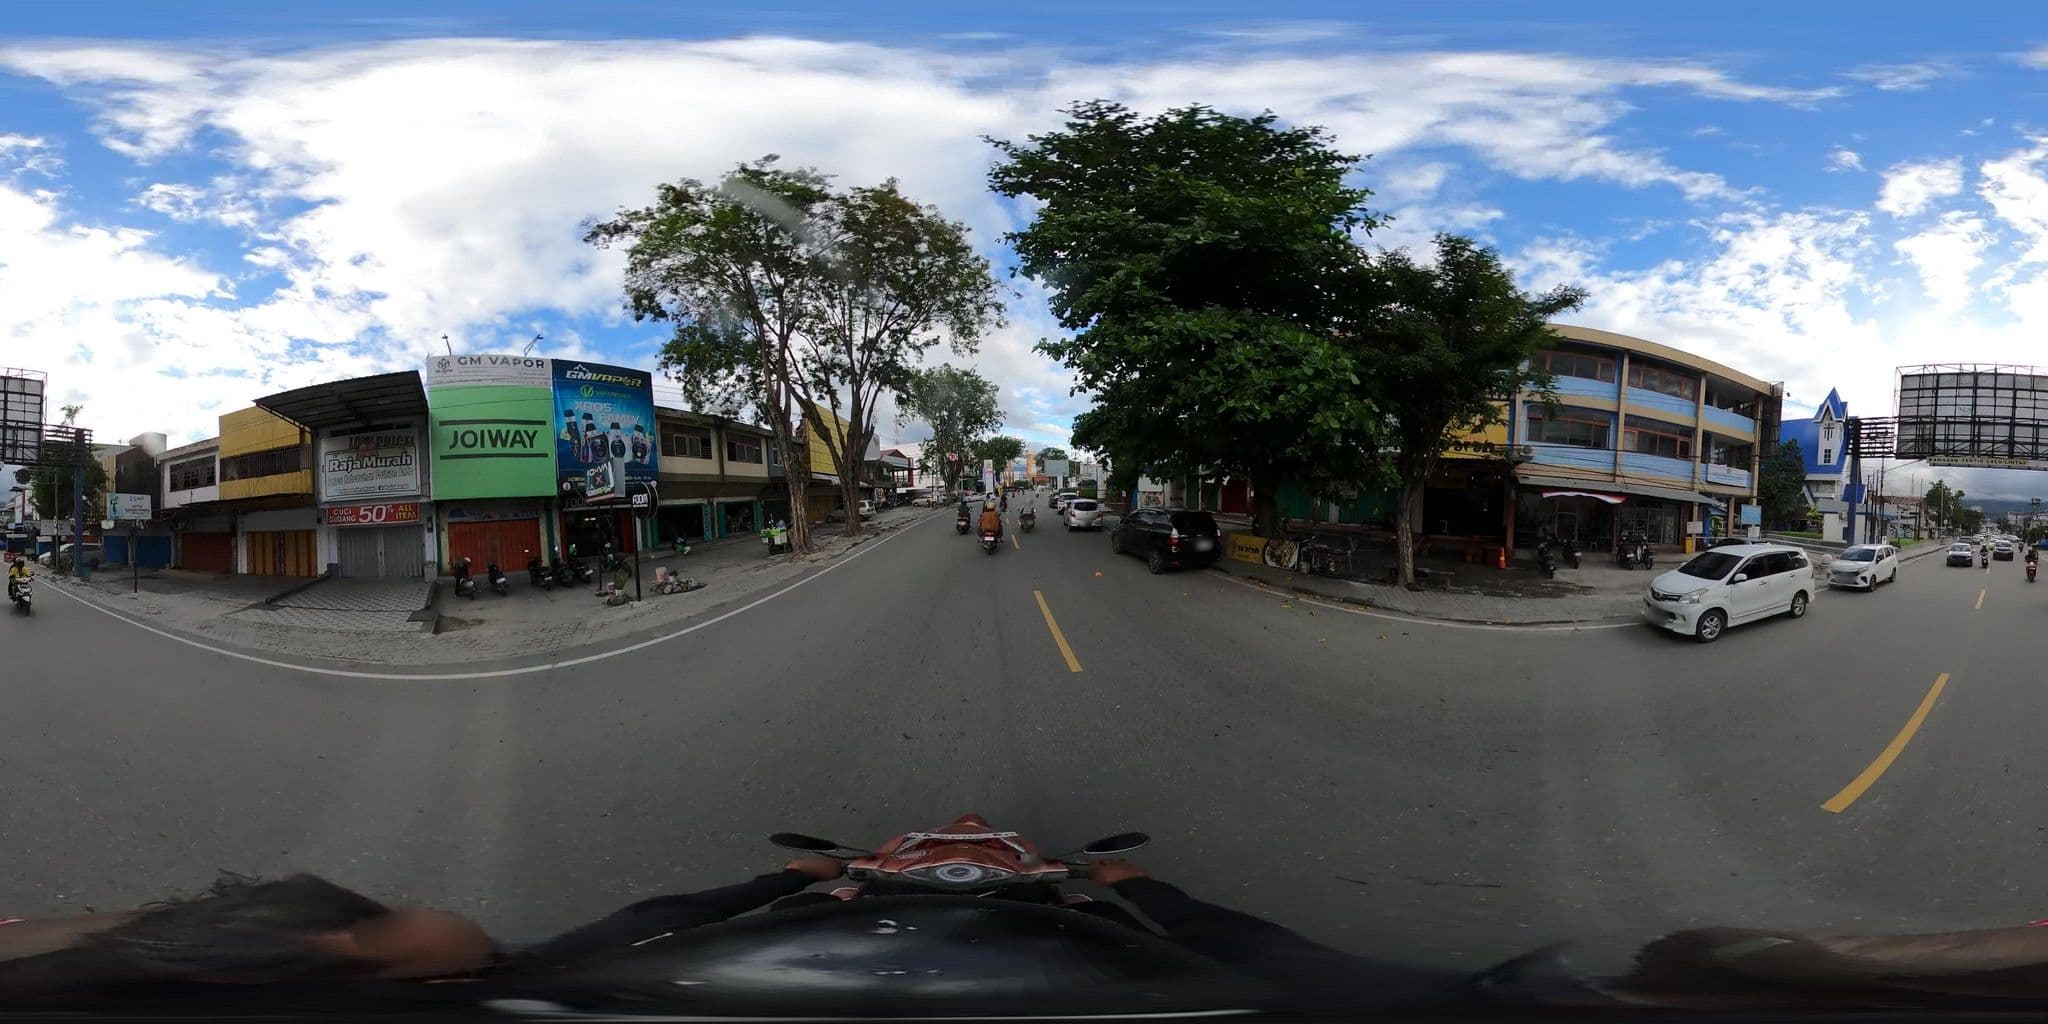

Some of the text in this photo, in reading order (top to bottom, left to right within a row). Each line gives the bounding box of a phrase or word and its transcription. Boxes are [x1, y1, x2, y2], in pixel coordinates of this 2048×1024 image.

[457, 355, 545, 369] GM VAPOR
[448, 429, 539, 450] JOIWAY
[333, 507, 352, 515] CUCI
[398, 504, 413, 512] ALL
[328, 515, 357, 523] GUDANG
[395, 511, 417, 520] ITEM
